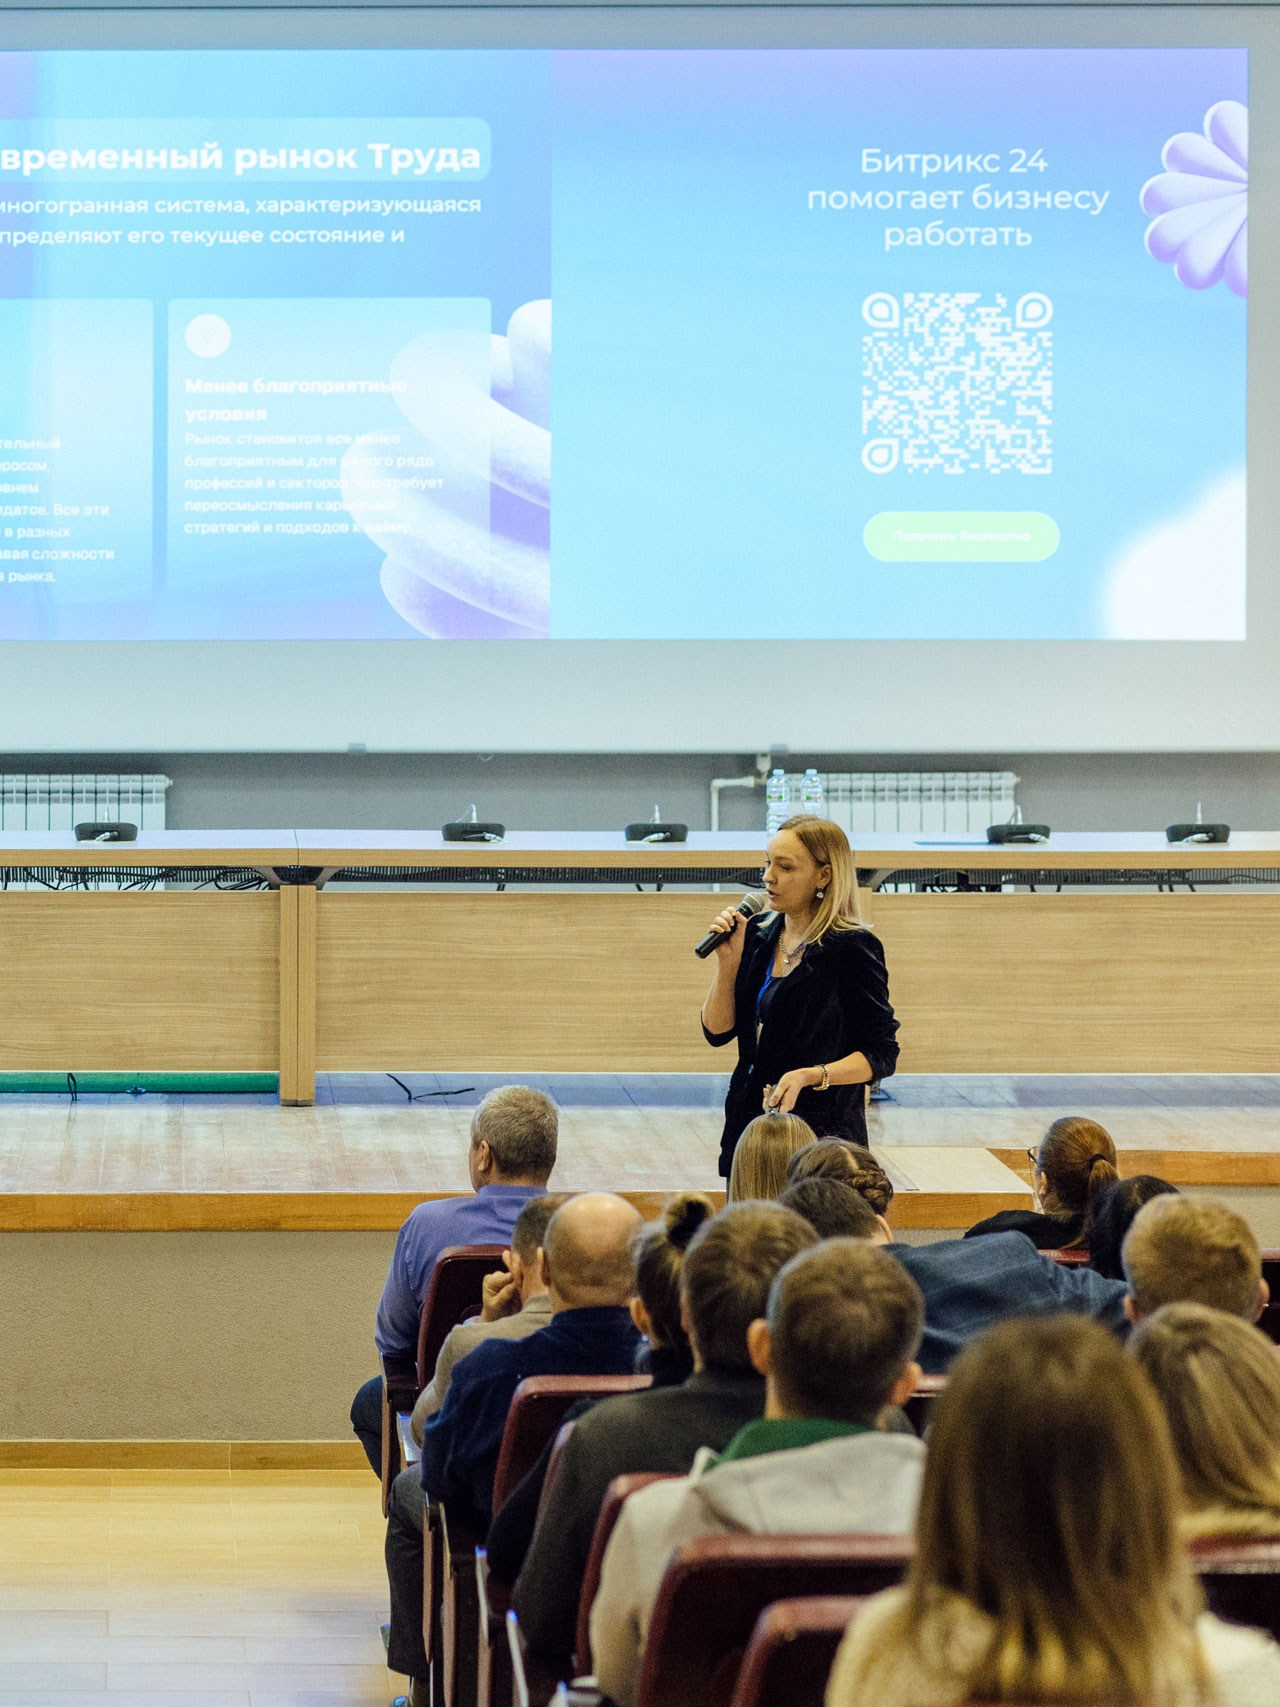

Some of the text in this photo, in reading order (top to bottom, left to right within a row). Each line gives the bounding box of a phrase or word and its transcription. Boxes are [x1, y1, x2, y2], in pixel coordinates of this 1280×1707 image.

[235, 146, 357, 175] рынок
[368, 143, 481, 174] Труда
[861, 148, 1048, 177] Битрикс 24
[154, 198, 250, 216] система,
[256, 197, 482, 217] характеризующаяся
[808, 183, 1109, 215] помогает бизнесу
[128, 229, 164, 244] его
[170, 229, 263, 246] текущее
[270, 229, 385, 244] состояние
[391, 229, 405, 244] и
[884, 220, 1033, 252] работать
[185, 377, 408, 396] Менее благоприятные
[185, 407, 268, 423] условия
[184, 433, 232, 446] Рынок
[237, 434, 322, 445] становится
[325, 434, 351, 445] все
[184, 455, 304, 469] благоприятным
[307, 456, 336, 469] для
[396, 456, 434, 469] ряда
[184, 476, 263, 491] профессий
[267, 478, 275, 489] и
[385, 476, 445, 491] требует
[53, 504, 80, 516] Все
[84, 505, 110, 516] эти
[184, 500, 312, 513] переосмысления
[5, 527, 13, 537] в
[17, 527, 71, 540] разных
[184, 520, 259, 535] стратегий
[264, 522, 273, 534] и
[276, 522, 349, 536] подходов
[352, 523, 360, 533] к
[32, 549, 115, 560] сложности
[8, 571, 56, 584] рынка.
